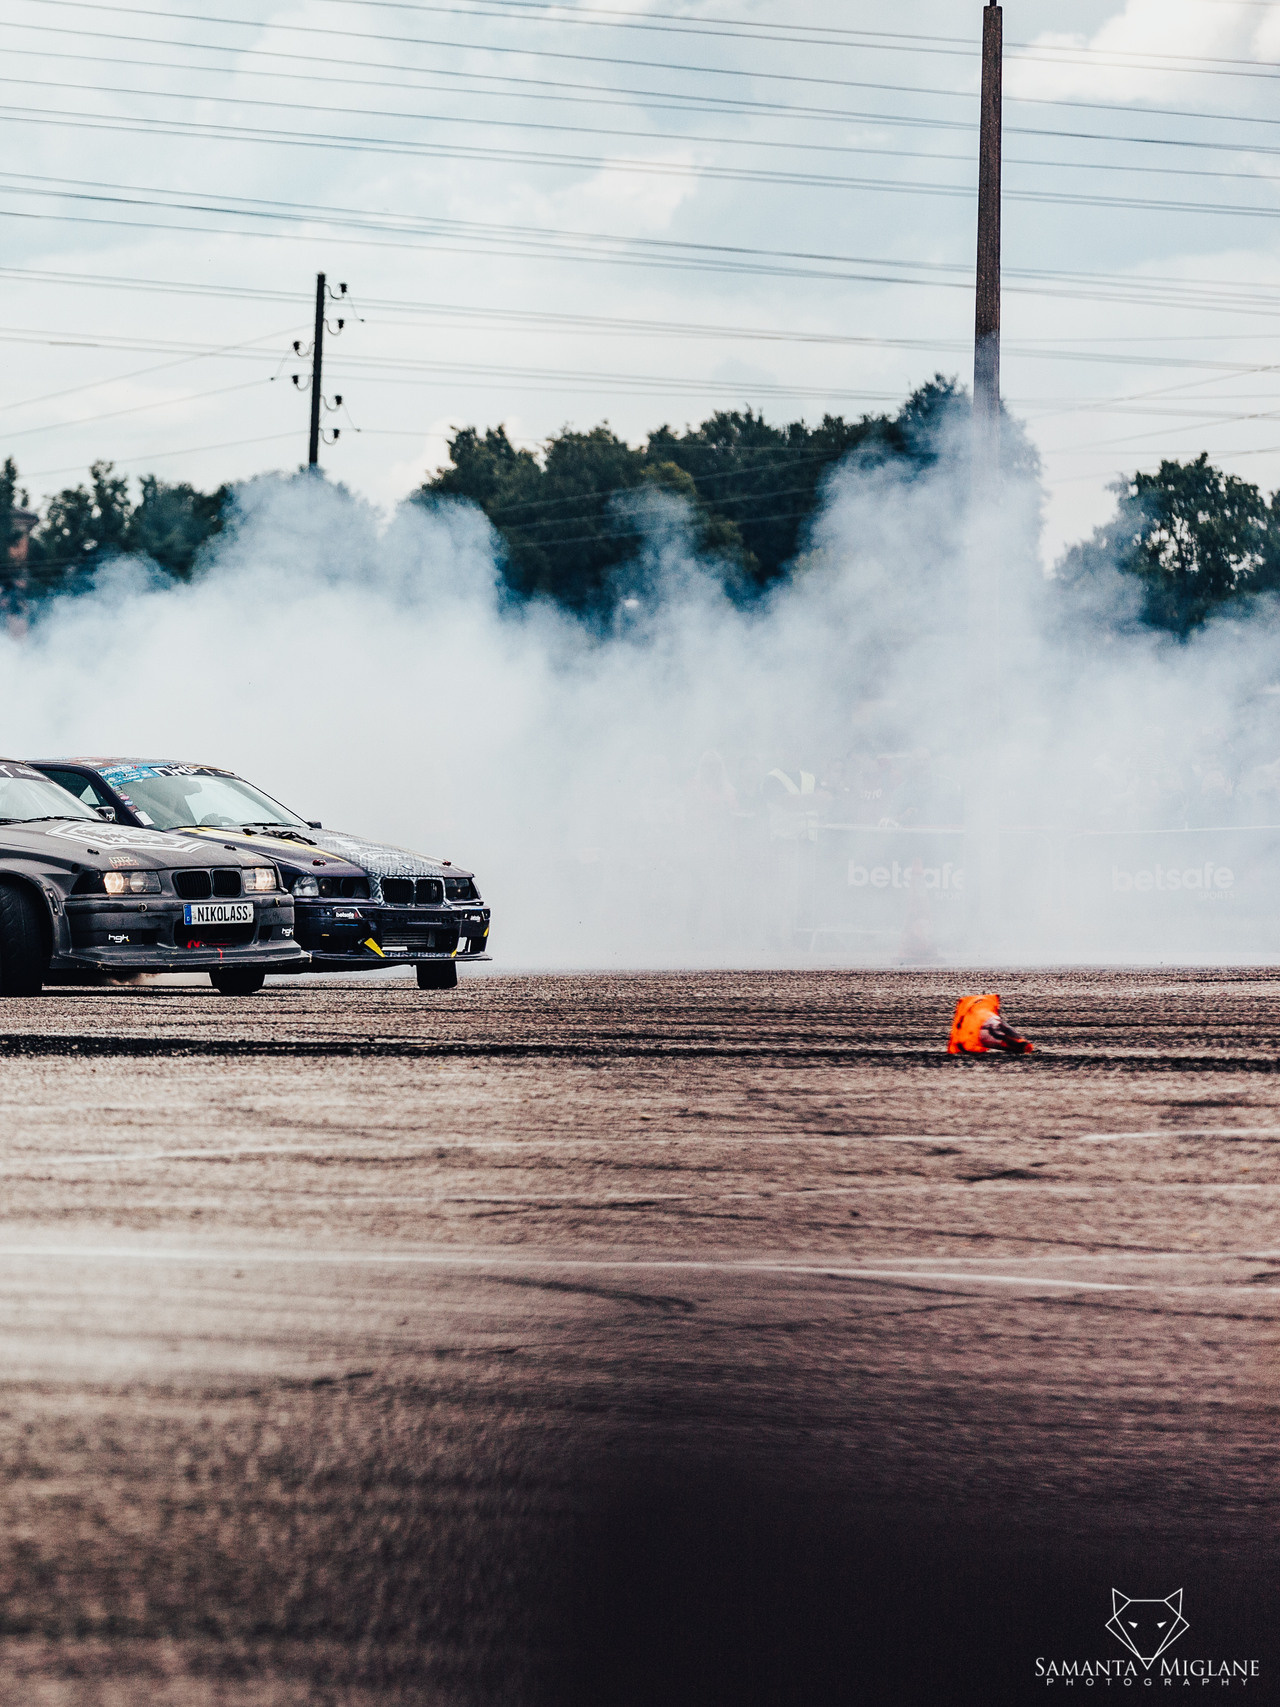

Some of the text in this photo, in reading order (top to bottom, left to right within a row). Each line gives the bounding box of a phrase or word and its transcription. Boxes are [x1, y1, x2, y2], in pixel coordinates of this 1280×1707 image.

[1111, 861, 1235, 892] betsafe
[197, 906, 248, 922] NIKOLASS
[108, 933, 129, 944] hgk
[281, 928, 294, 938] hgk
